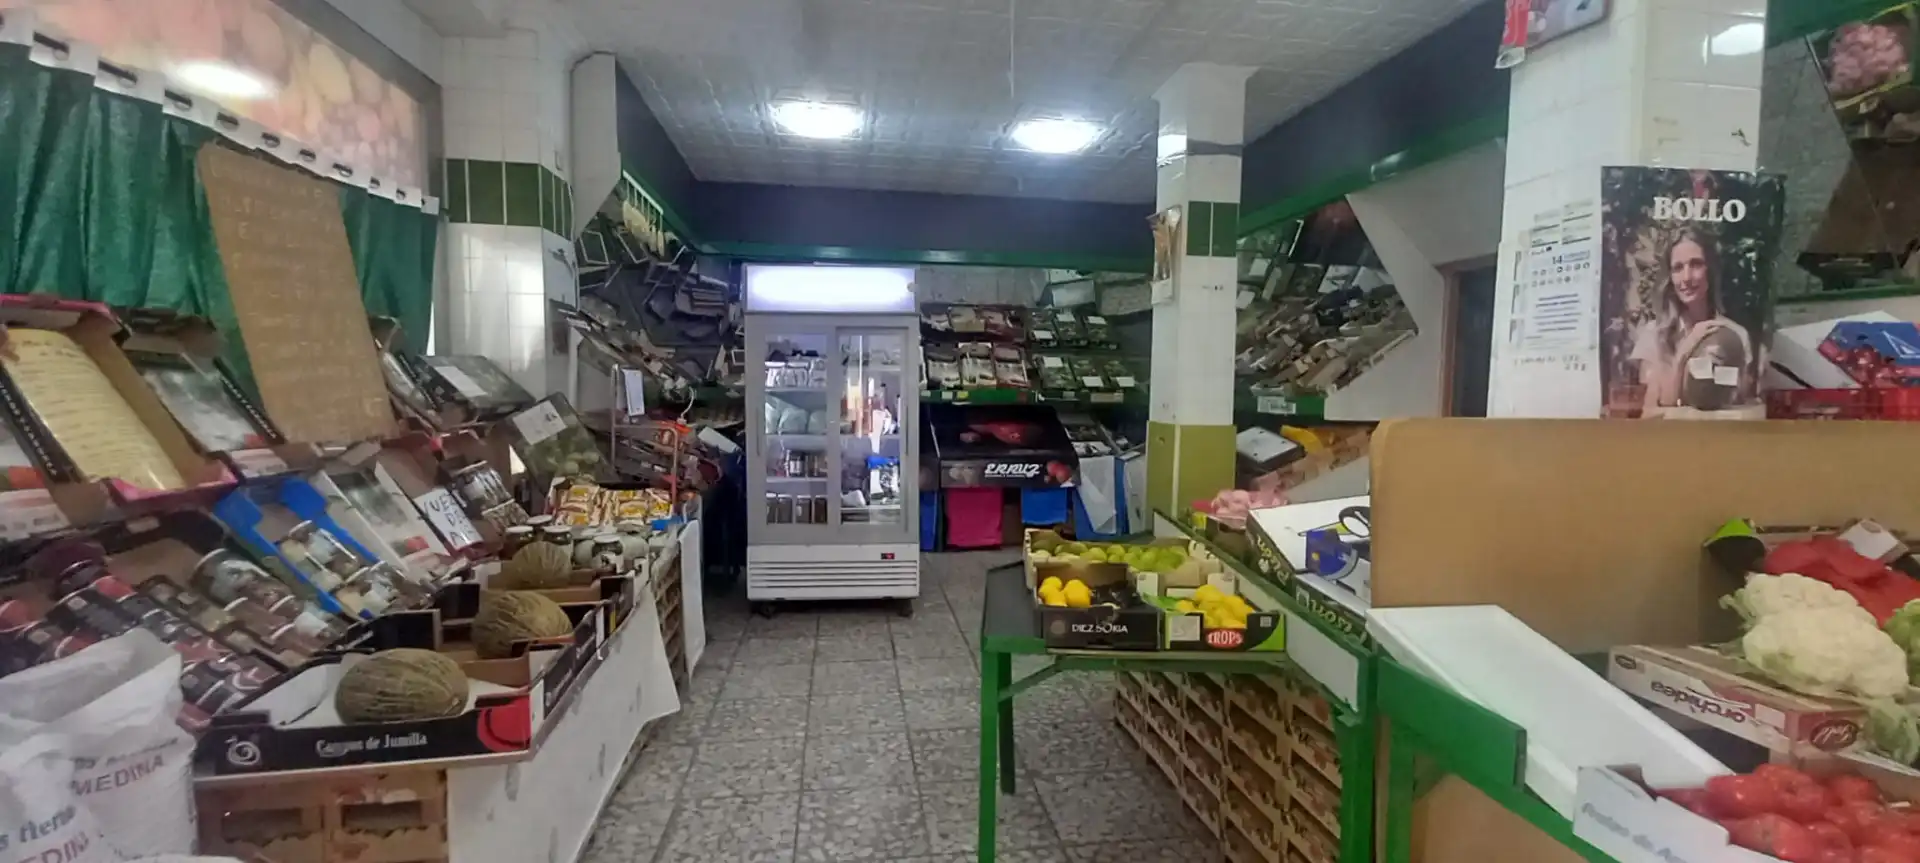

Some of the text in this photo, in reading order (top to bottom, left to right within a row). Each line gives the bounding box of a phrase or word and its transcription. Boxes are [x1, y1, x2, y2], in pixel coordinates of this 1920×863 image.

[1652, 196, 1746, 222] BOLLO
[365, 736, 380, 750] de
[382, 732, 428, 749] Jumilla
[71, 754, 165, 796] MEDINA
